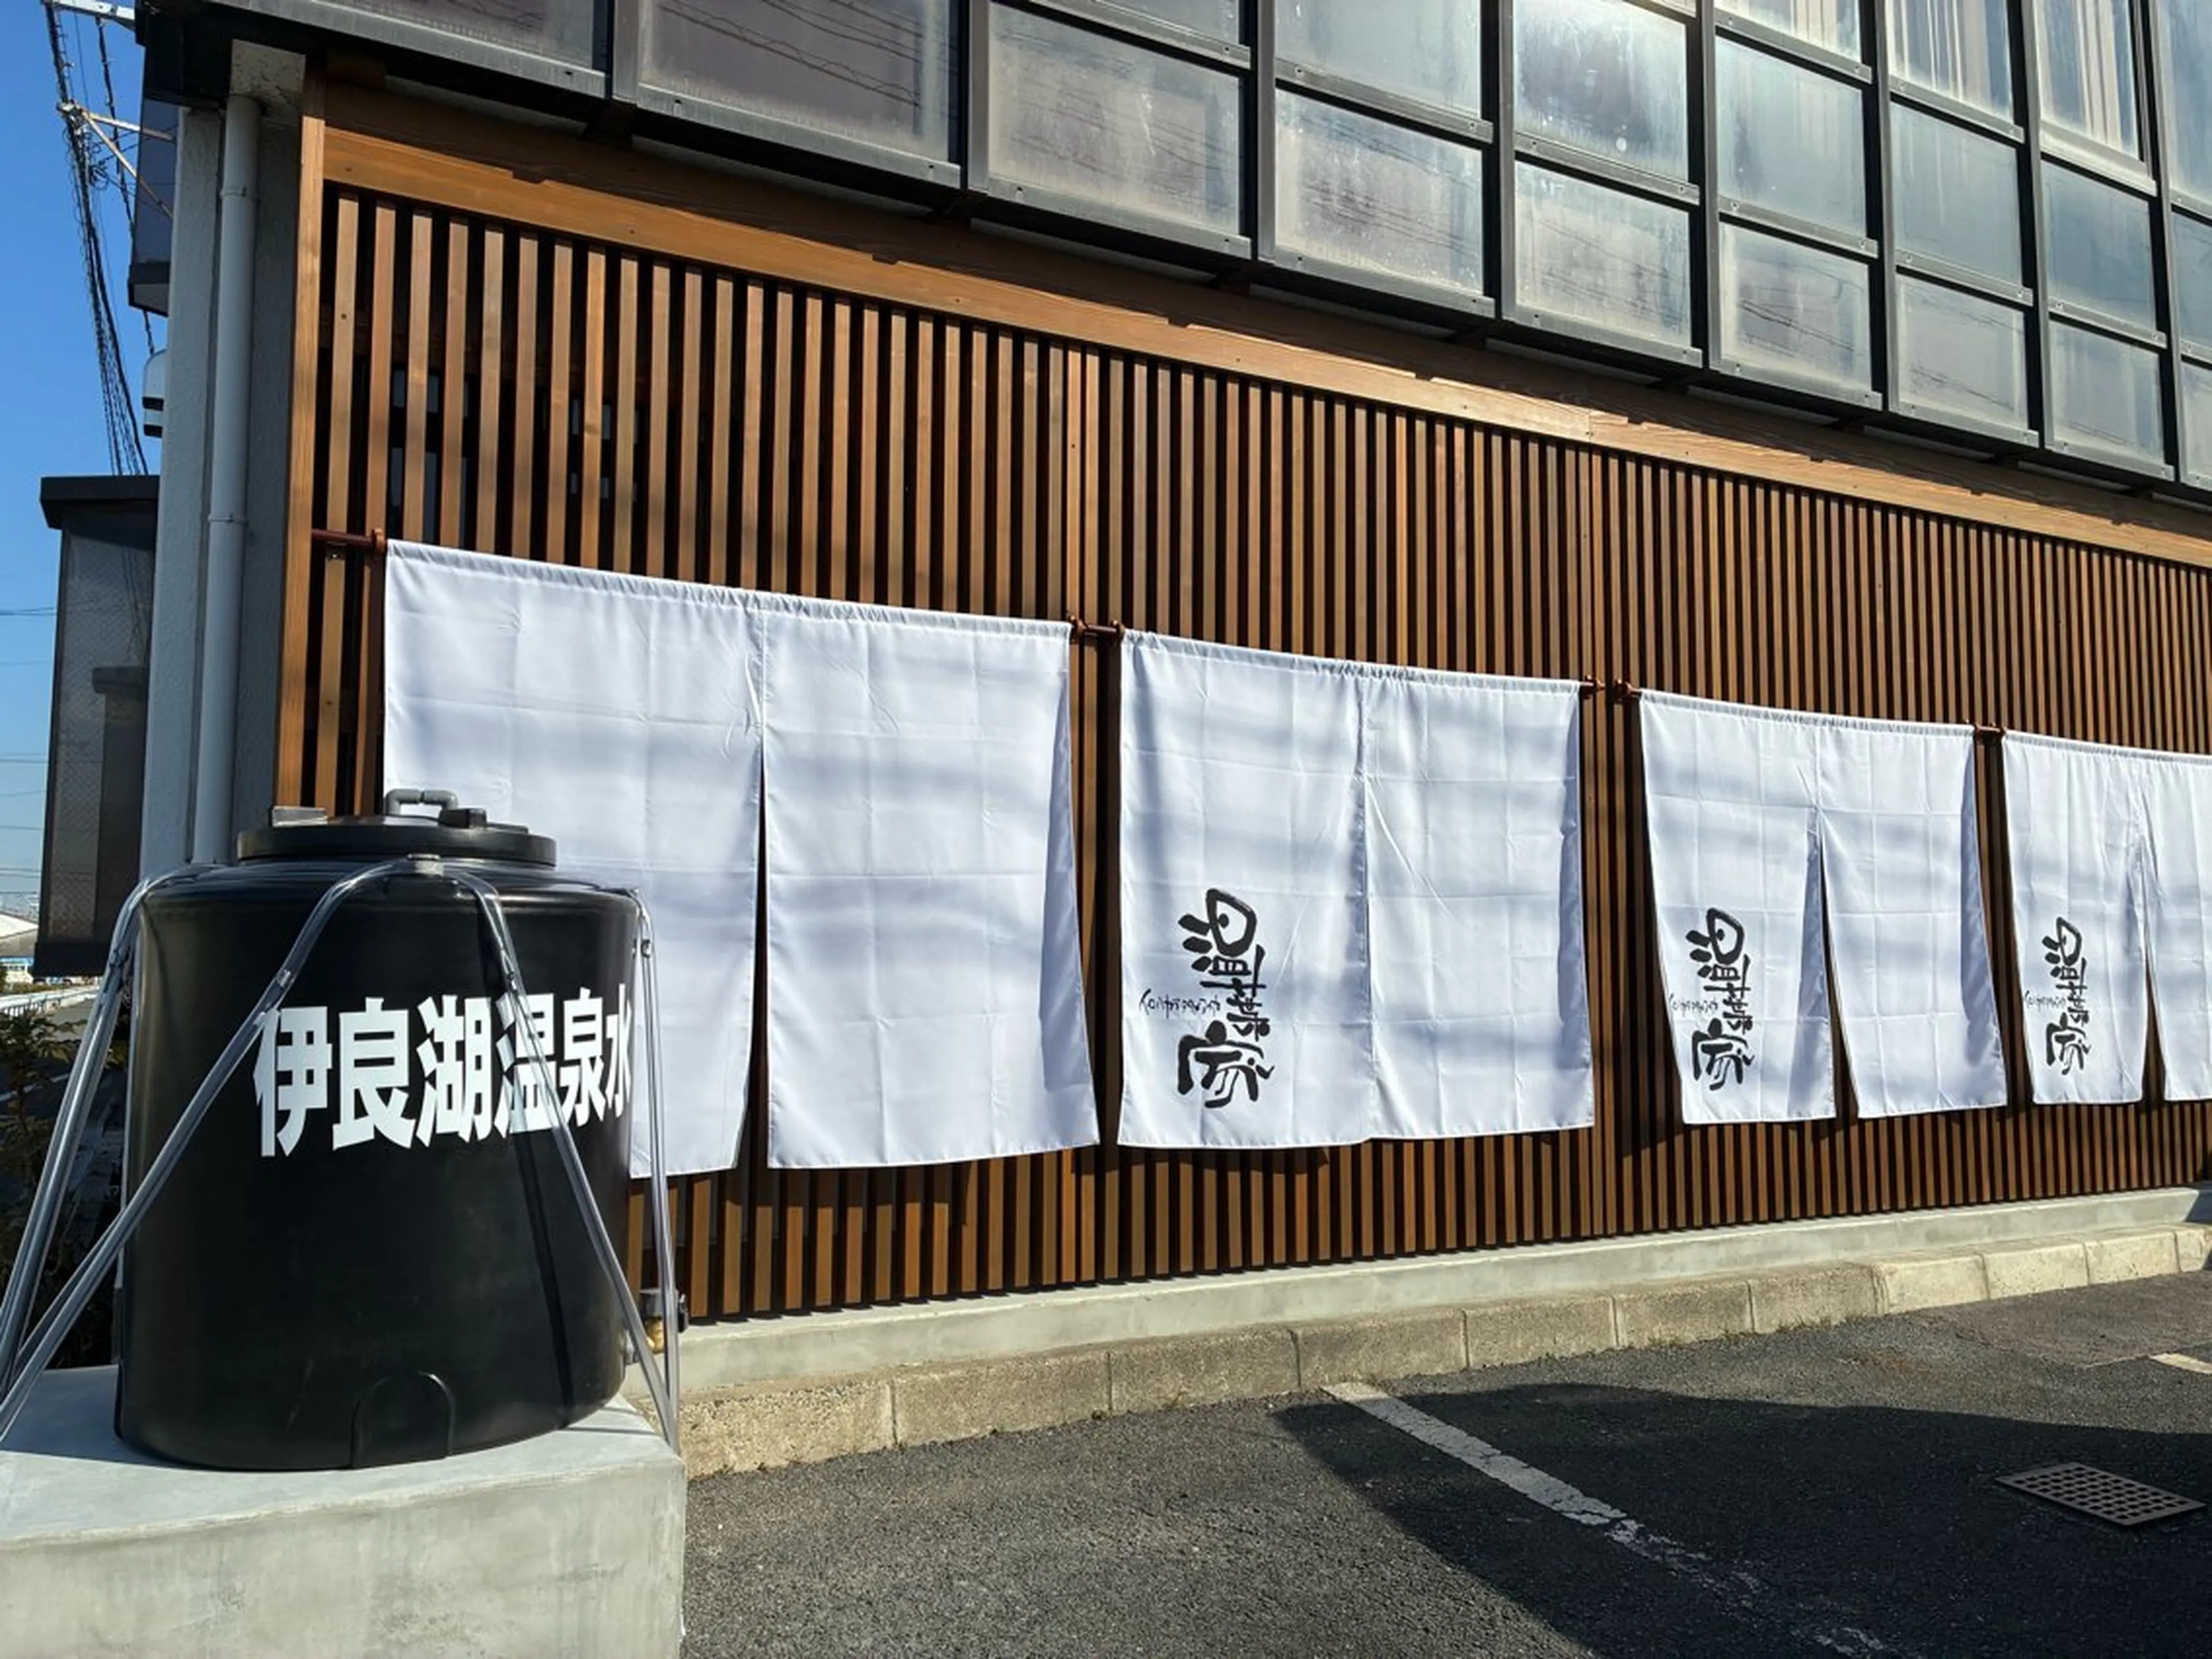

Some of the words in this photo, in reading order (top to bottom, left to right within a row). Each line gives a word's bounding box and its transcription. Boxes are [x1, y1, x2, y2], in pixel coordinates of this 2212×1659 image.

[253, 983, 632, 1158] 伊良湖温泉水
